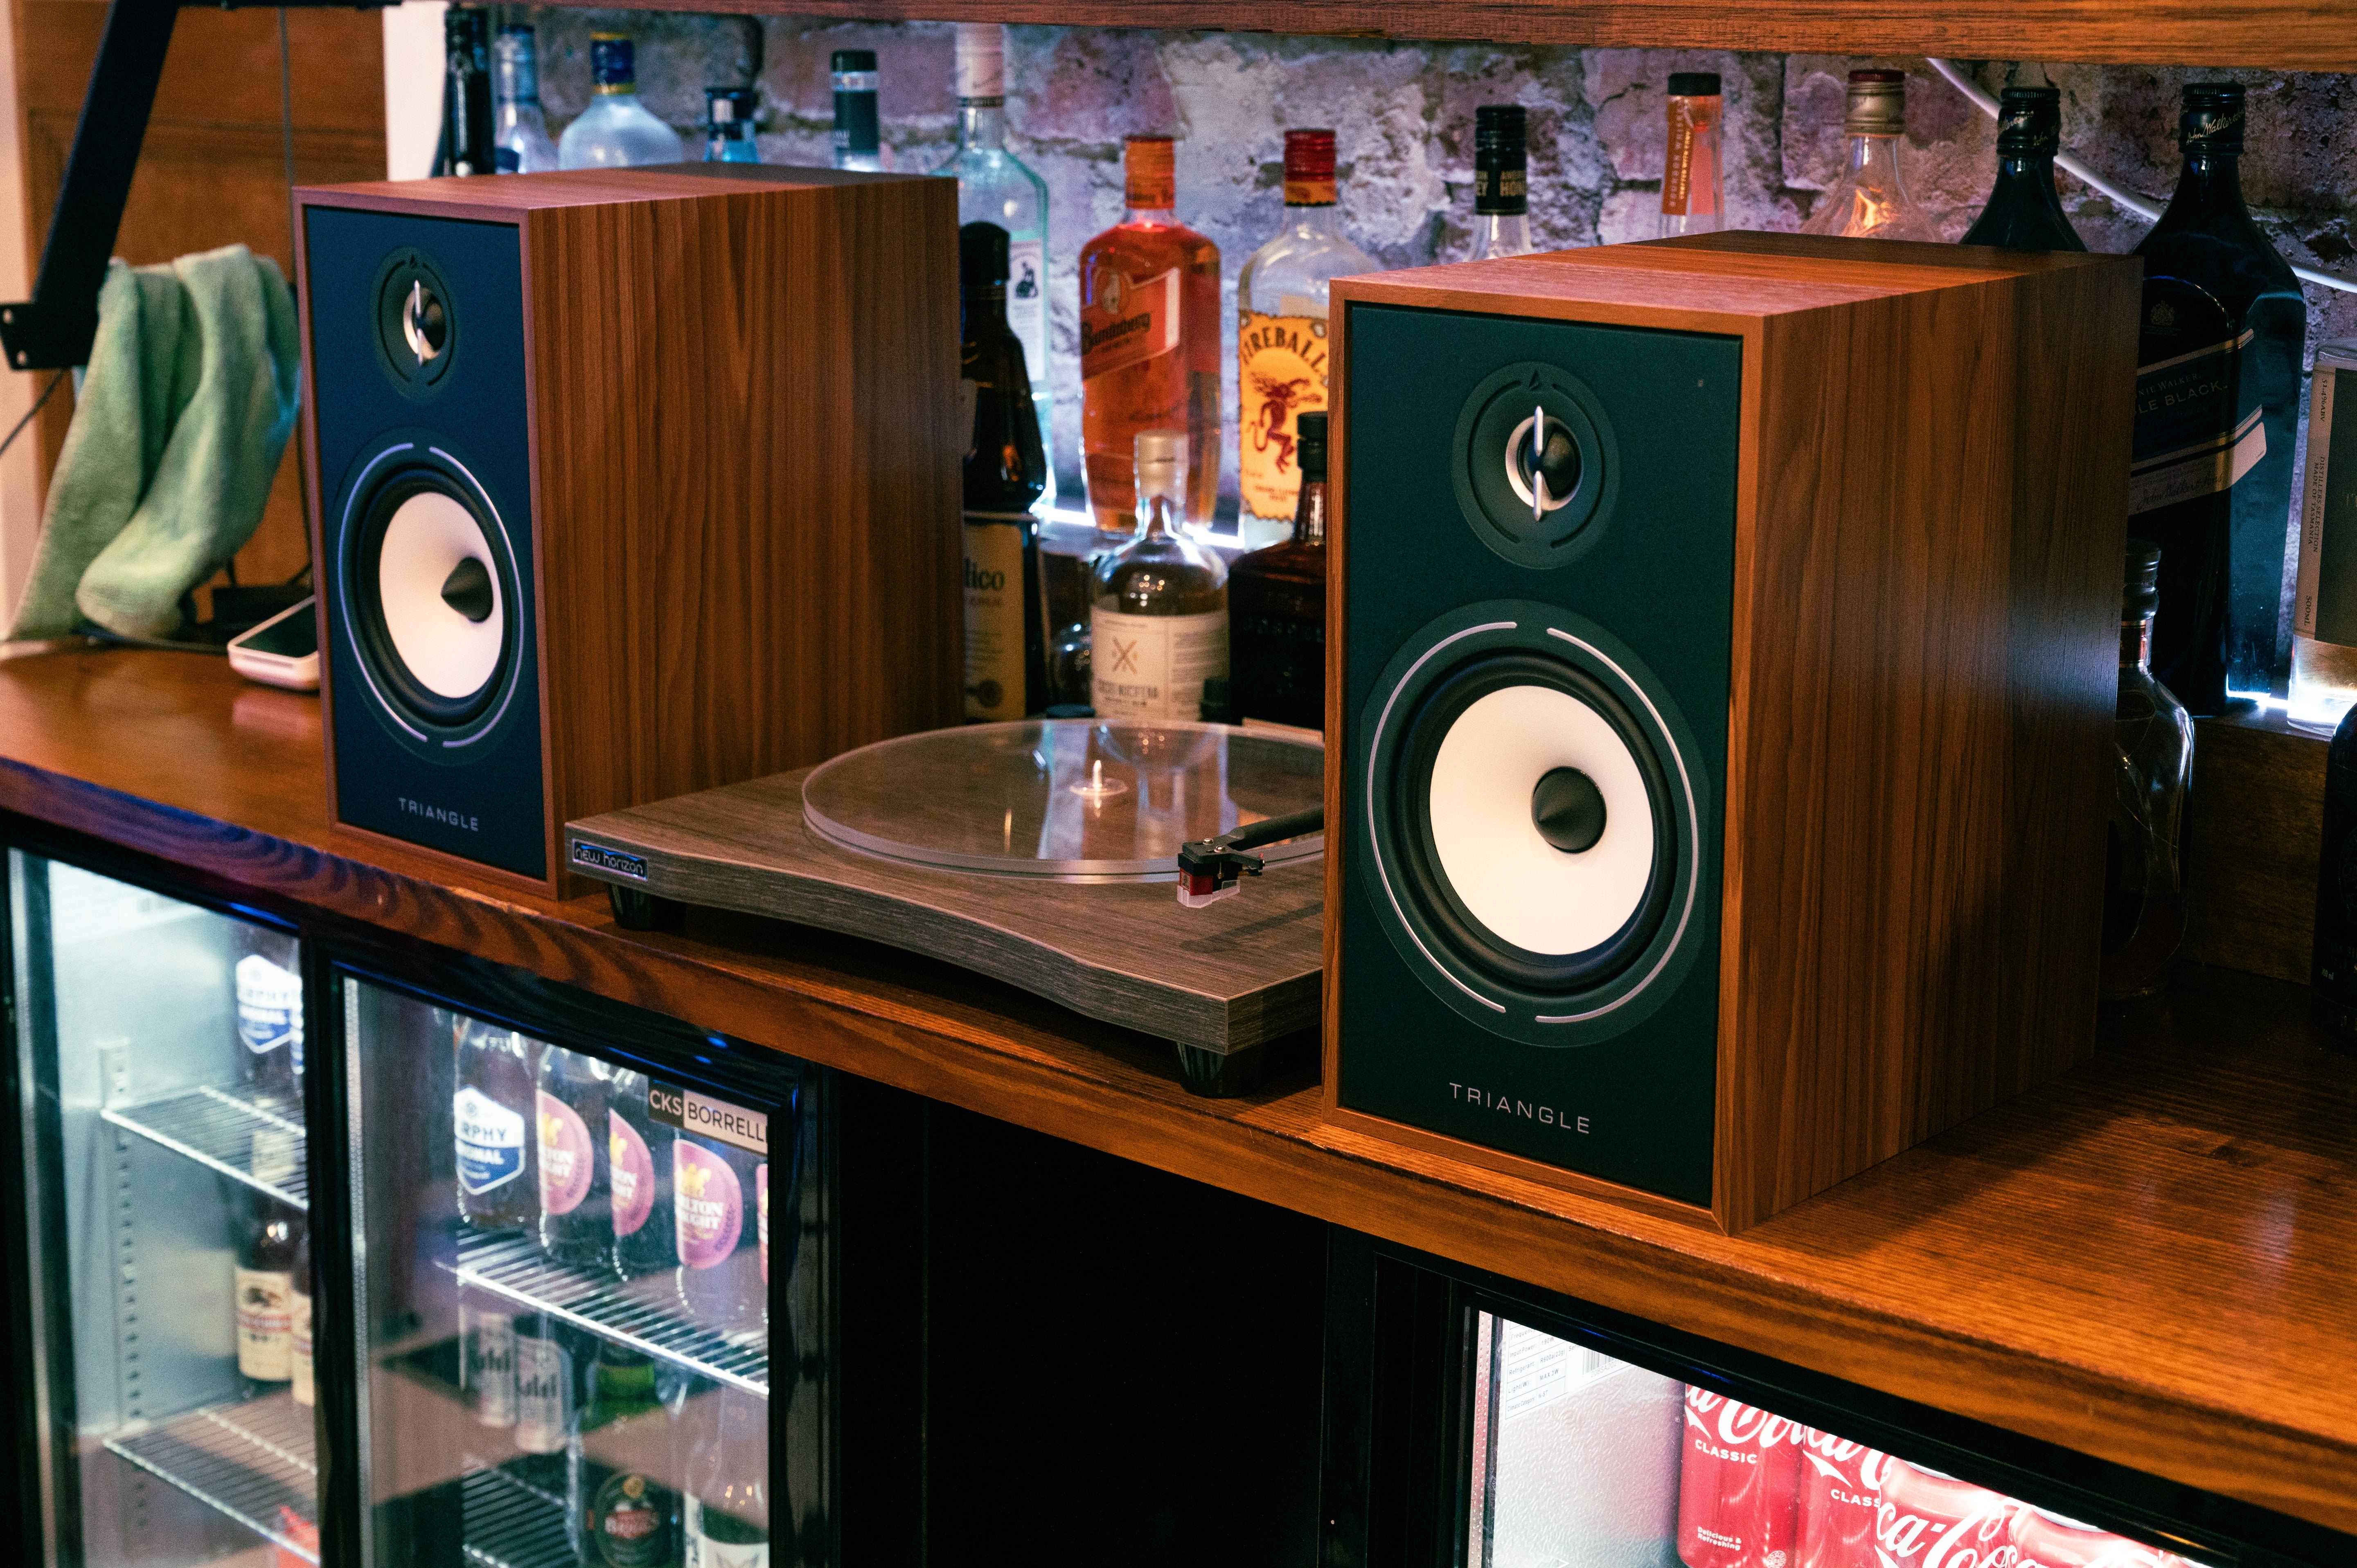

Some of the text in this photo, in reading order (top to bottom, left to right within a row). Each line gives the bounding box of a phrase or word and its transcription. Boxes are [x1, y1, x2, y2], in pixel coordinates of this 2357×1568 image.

[2203, 112, 2233, 136] Walker
[2317, 457, 2325, 504] DISTILLERS
[2312, 489, 2317, 500] OF
[2308, 502, 2316, 544] TASMANIA
[399, 797, 479, 832] TRIANGLE
[603, 852, 644, 875] horizon
[649, 1089, 683, 1116] CKS
[1449, 1082, 1589, 1134] TRIANGLE
[1695, 1439, 1757, 1464] CLASSIC
[1697, 1526, 1733, 1543] Delicious
[1697, 1532, 1741, 1551] Refreshing
